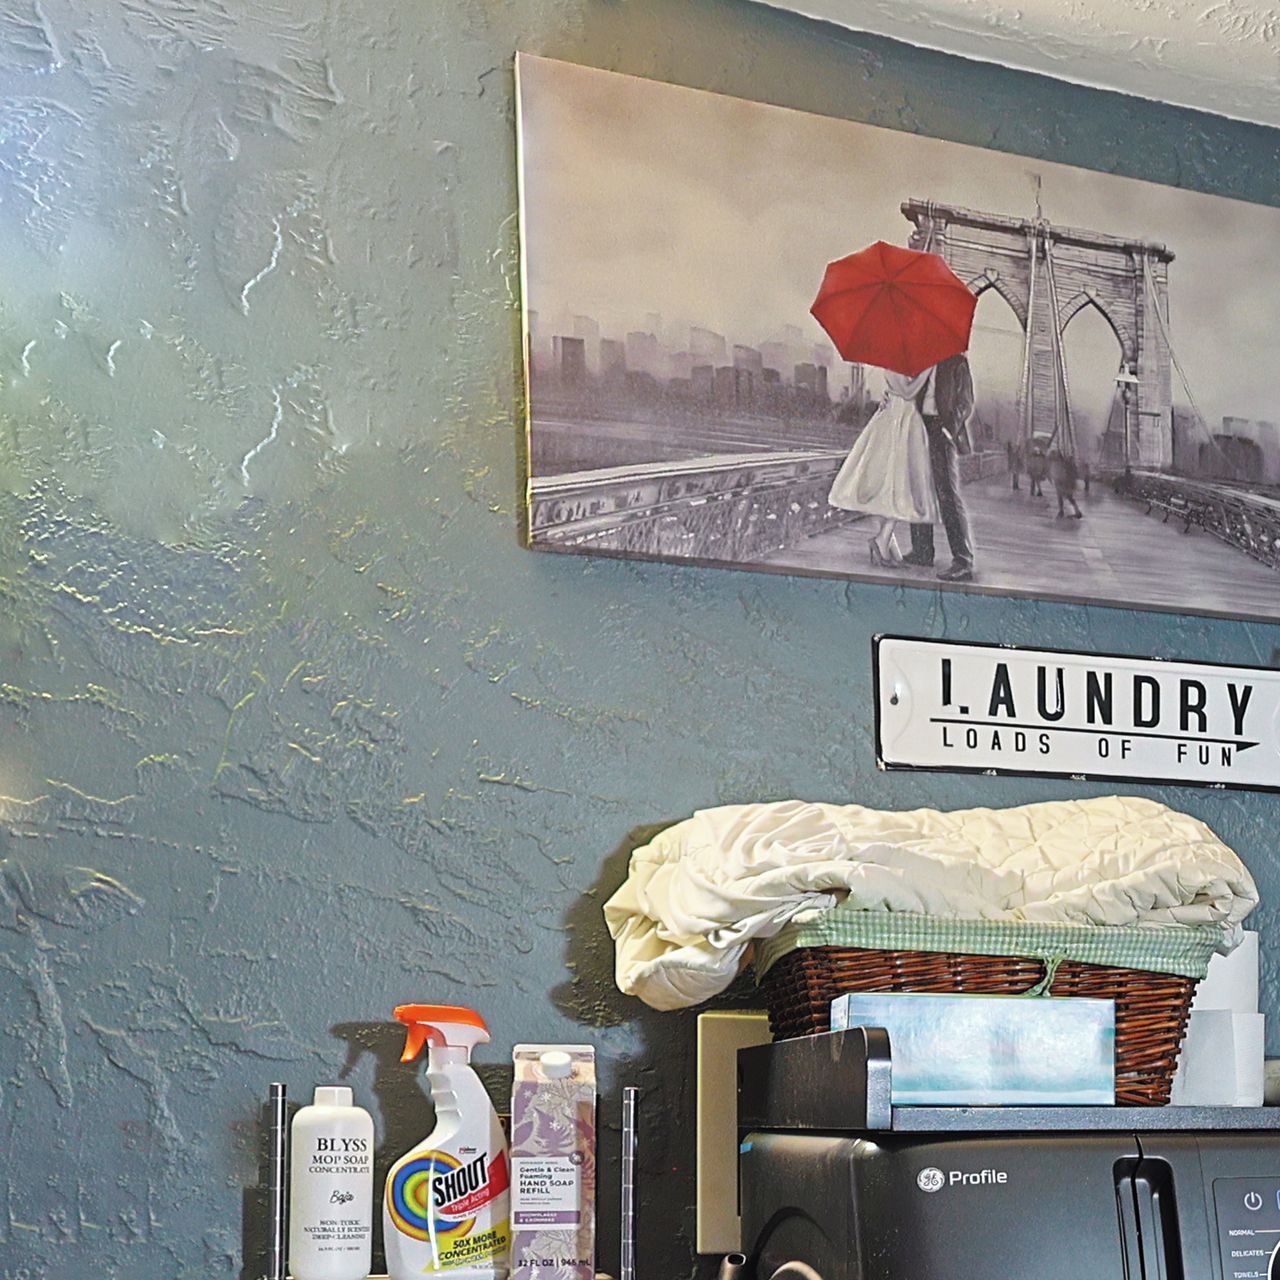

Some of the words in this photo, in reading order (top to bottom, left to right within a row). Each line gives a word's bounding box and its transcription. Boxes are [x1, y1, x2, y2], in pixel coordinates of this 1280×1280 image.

[941, 658, 1253, 736] LAUNDRY
[943, 726, 1050, 755] LOADS
[1098, 737, 1132, 759] OF
[1177, 743, 1232, 767] FUN
[317, 1137, 367, 1152] BLYSS
[312, 1154, 341, 1165] MOP
[343, 1154, 369, 1165] SOAP
[432, 1151, 488, 1207] SHOUT
[949, 1169, 1008, 1186] Profile
[439, 1235, 506, 1261] CONCENTRATED
[452, 1238, 471, 1249] 50X
[472, 1231, 497, 1245] MORE
